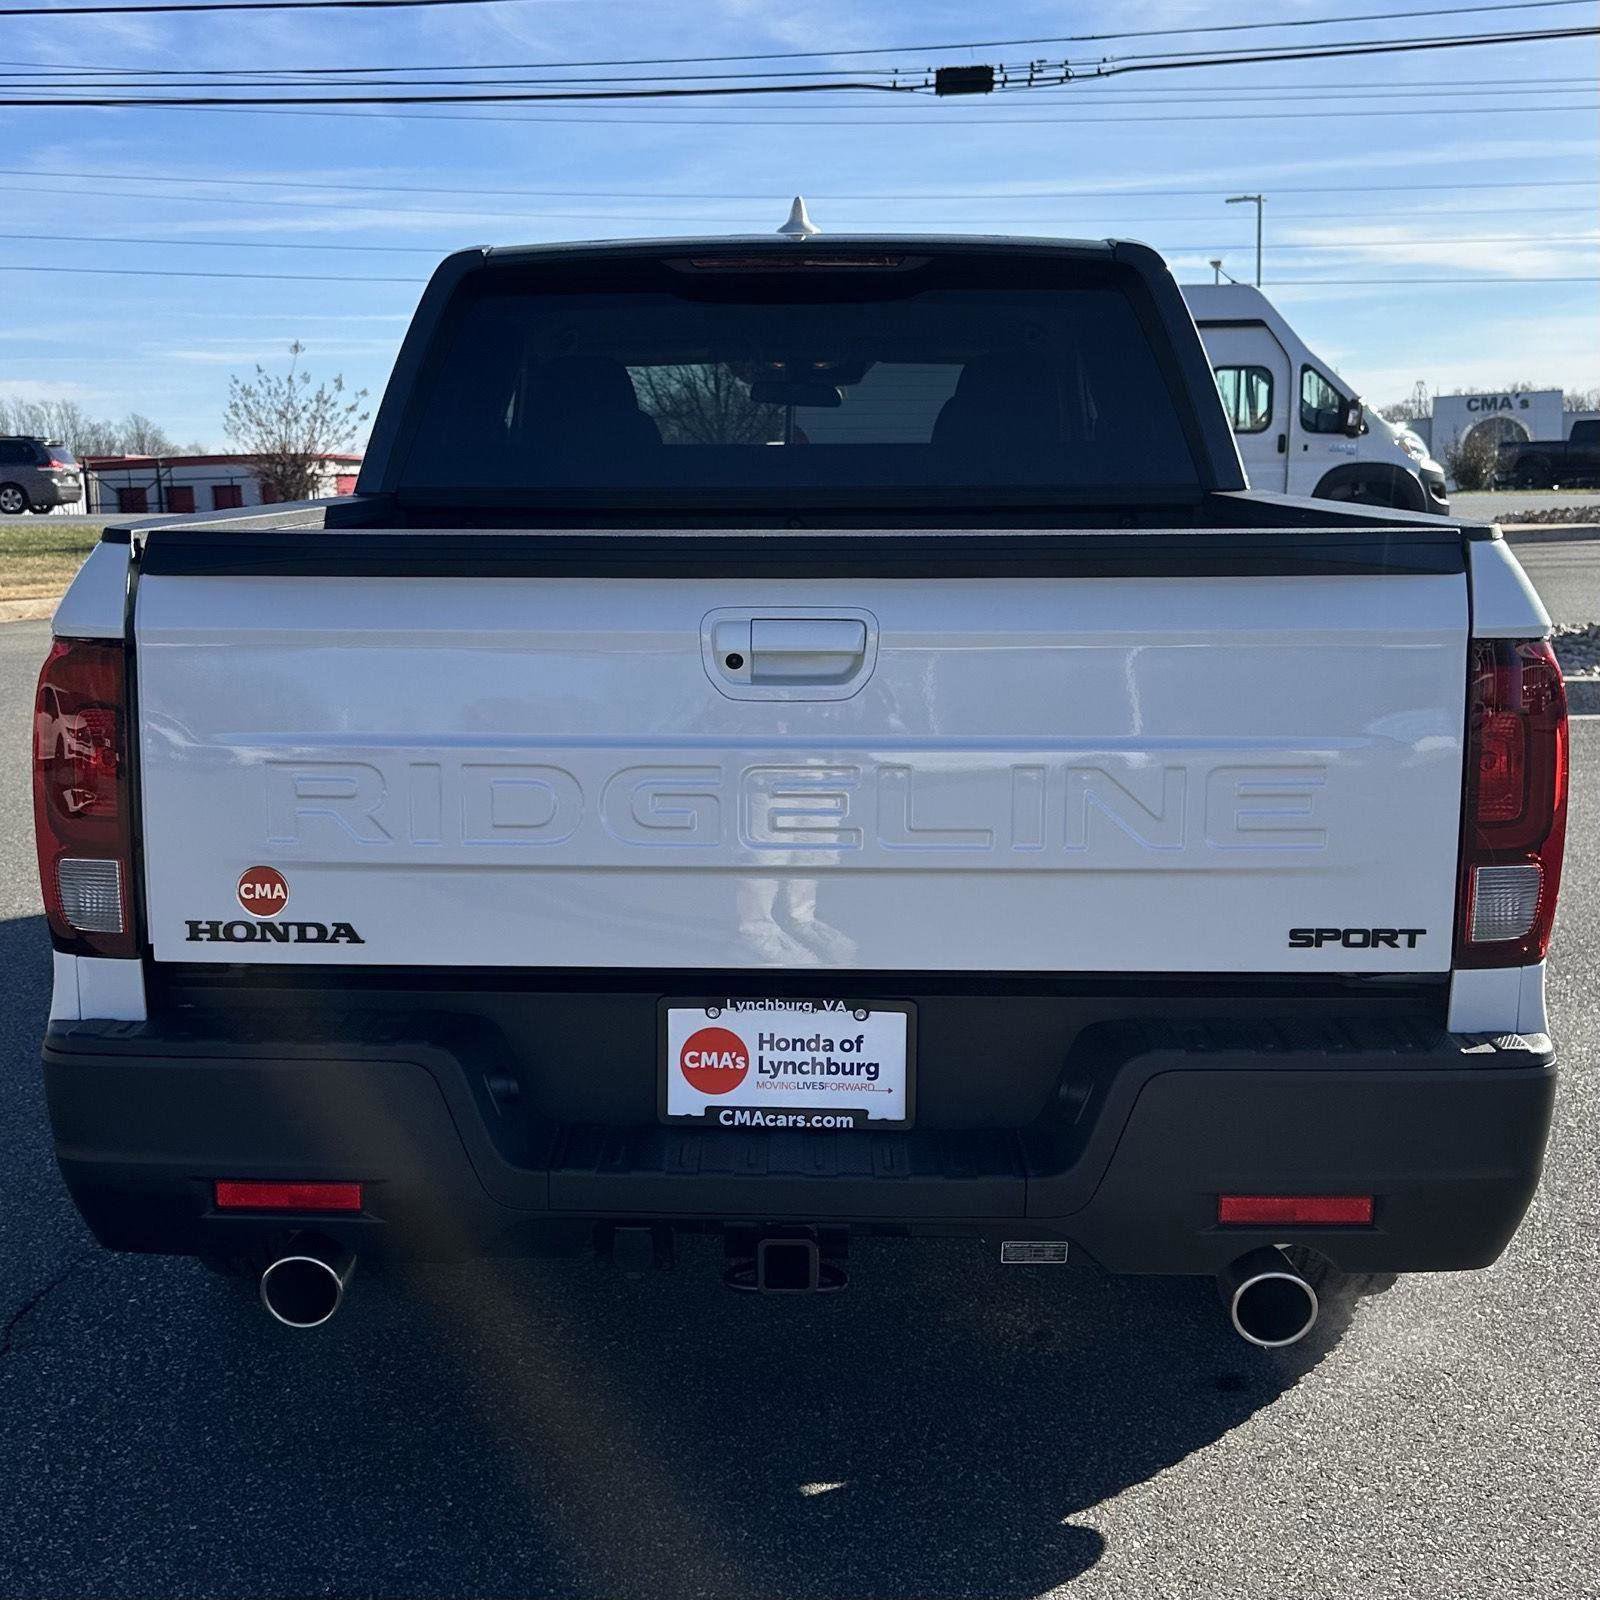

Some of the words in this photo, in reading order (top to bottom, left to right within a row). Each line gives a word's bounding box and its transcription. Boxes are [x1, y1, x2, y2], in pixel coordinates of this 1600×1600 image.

[1466, 392, 1530, 412] CMA's
[267, 761, 1327, 850] RIDGELINE
[239, 883, 286, 900] CMA
[185, 920, 365, 944] HONDA
[1289, 928, 1427, 948] SPORT
[726, 999, 818, 1013] Lynchburg,
[823, 1001, 847, 1012] VA
[758, 1033, 834, 1052] Honda
[839, 1034, 864, 1053] of
[684, 1051, 746, 1070] CMA's
[758, 1057, 880, 1080] Lynchburg
[719, 1110, 854, 1128] CMAcars.com
